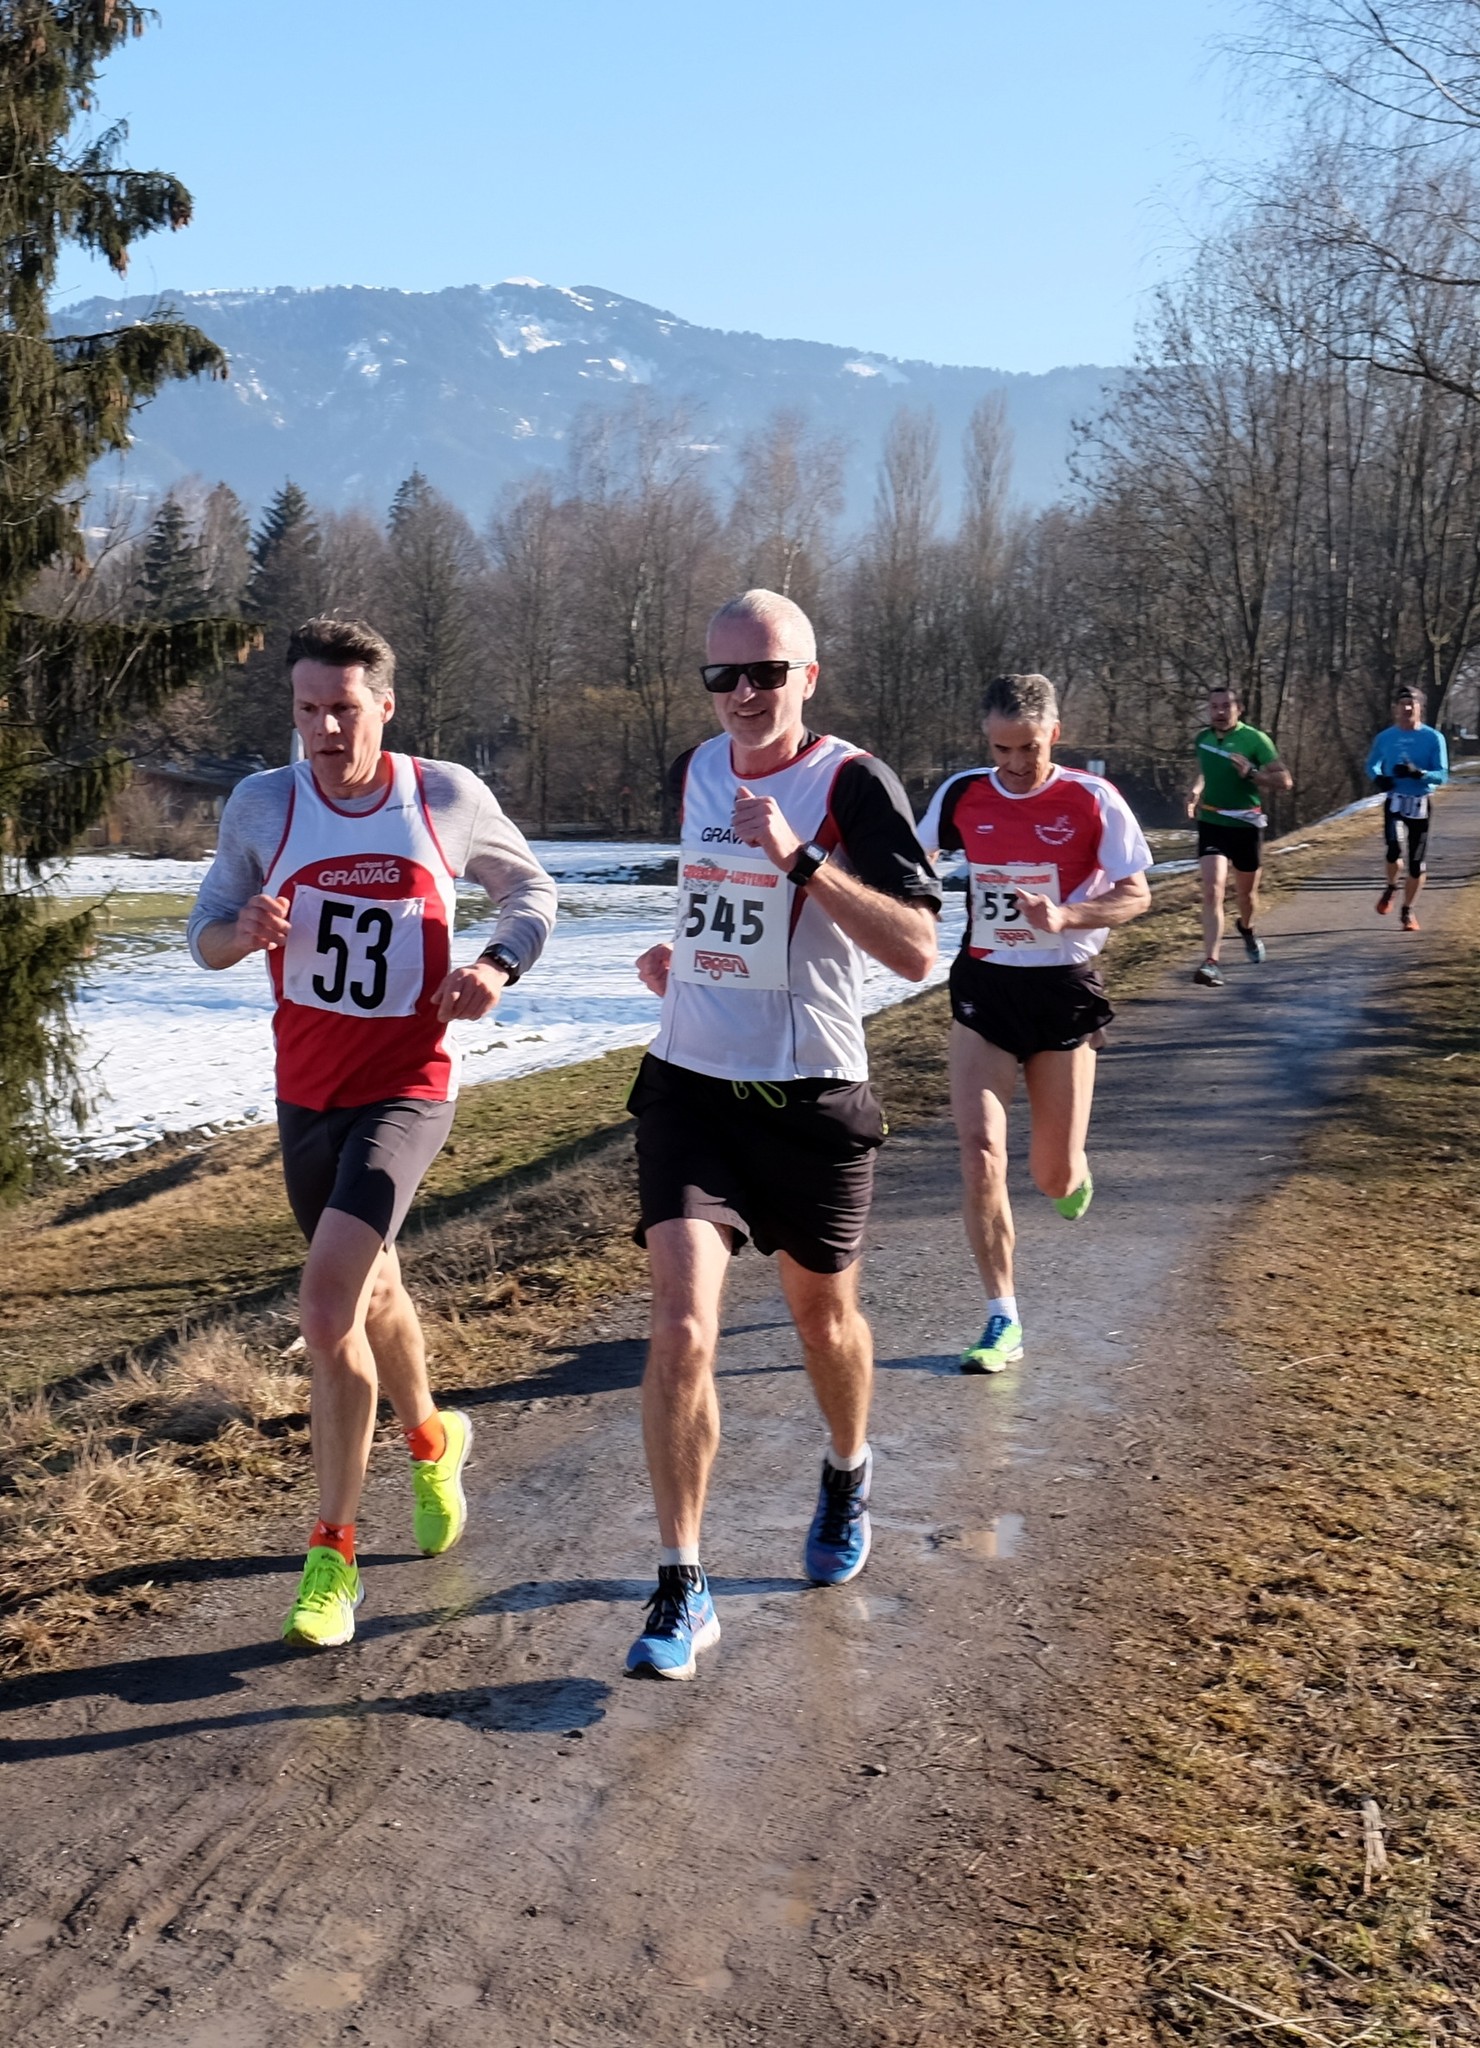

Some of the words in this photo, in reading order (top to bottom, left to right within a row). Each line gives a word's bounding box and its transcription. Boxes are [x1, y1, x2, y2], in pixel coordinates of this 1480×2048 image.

[318, 867, 400, 887] GRAVAG
[686, 892, 764, 945] 545
[983, 891, 1038, 922] 53
[312, 899, 393, 1010] 53
